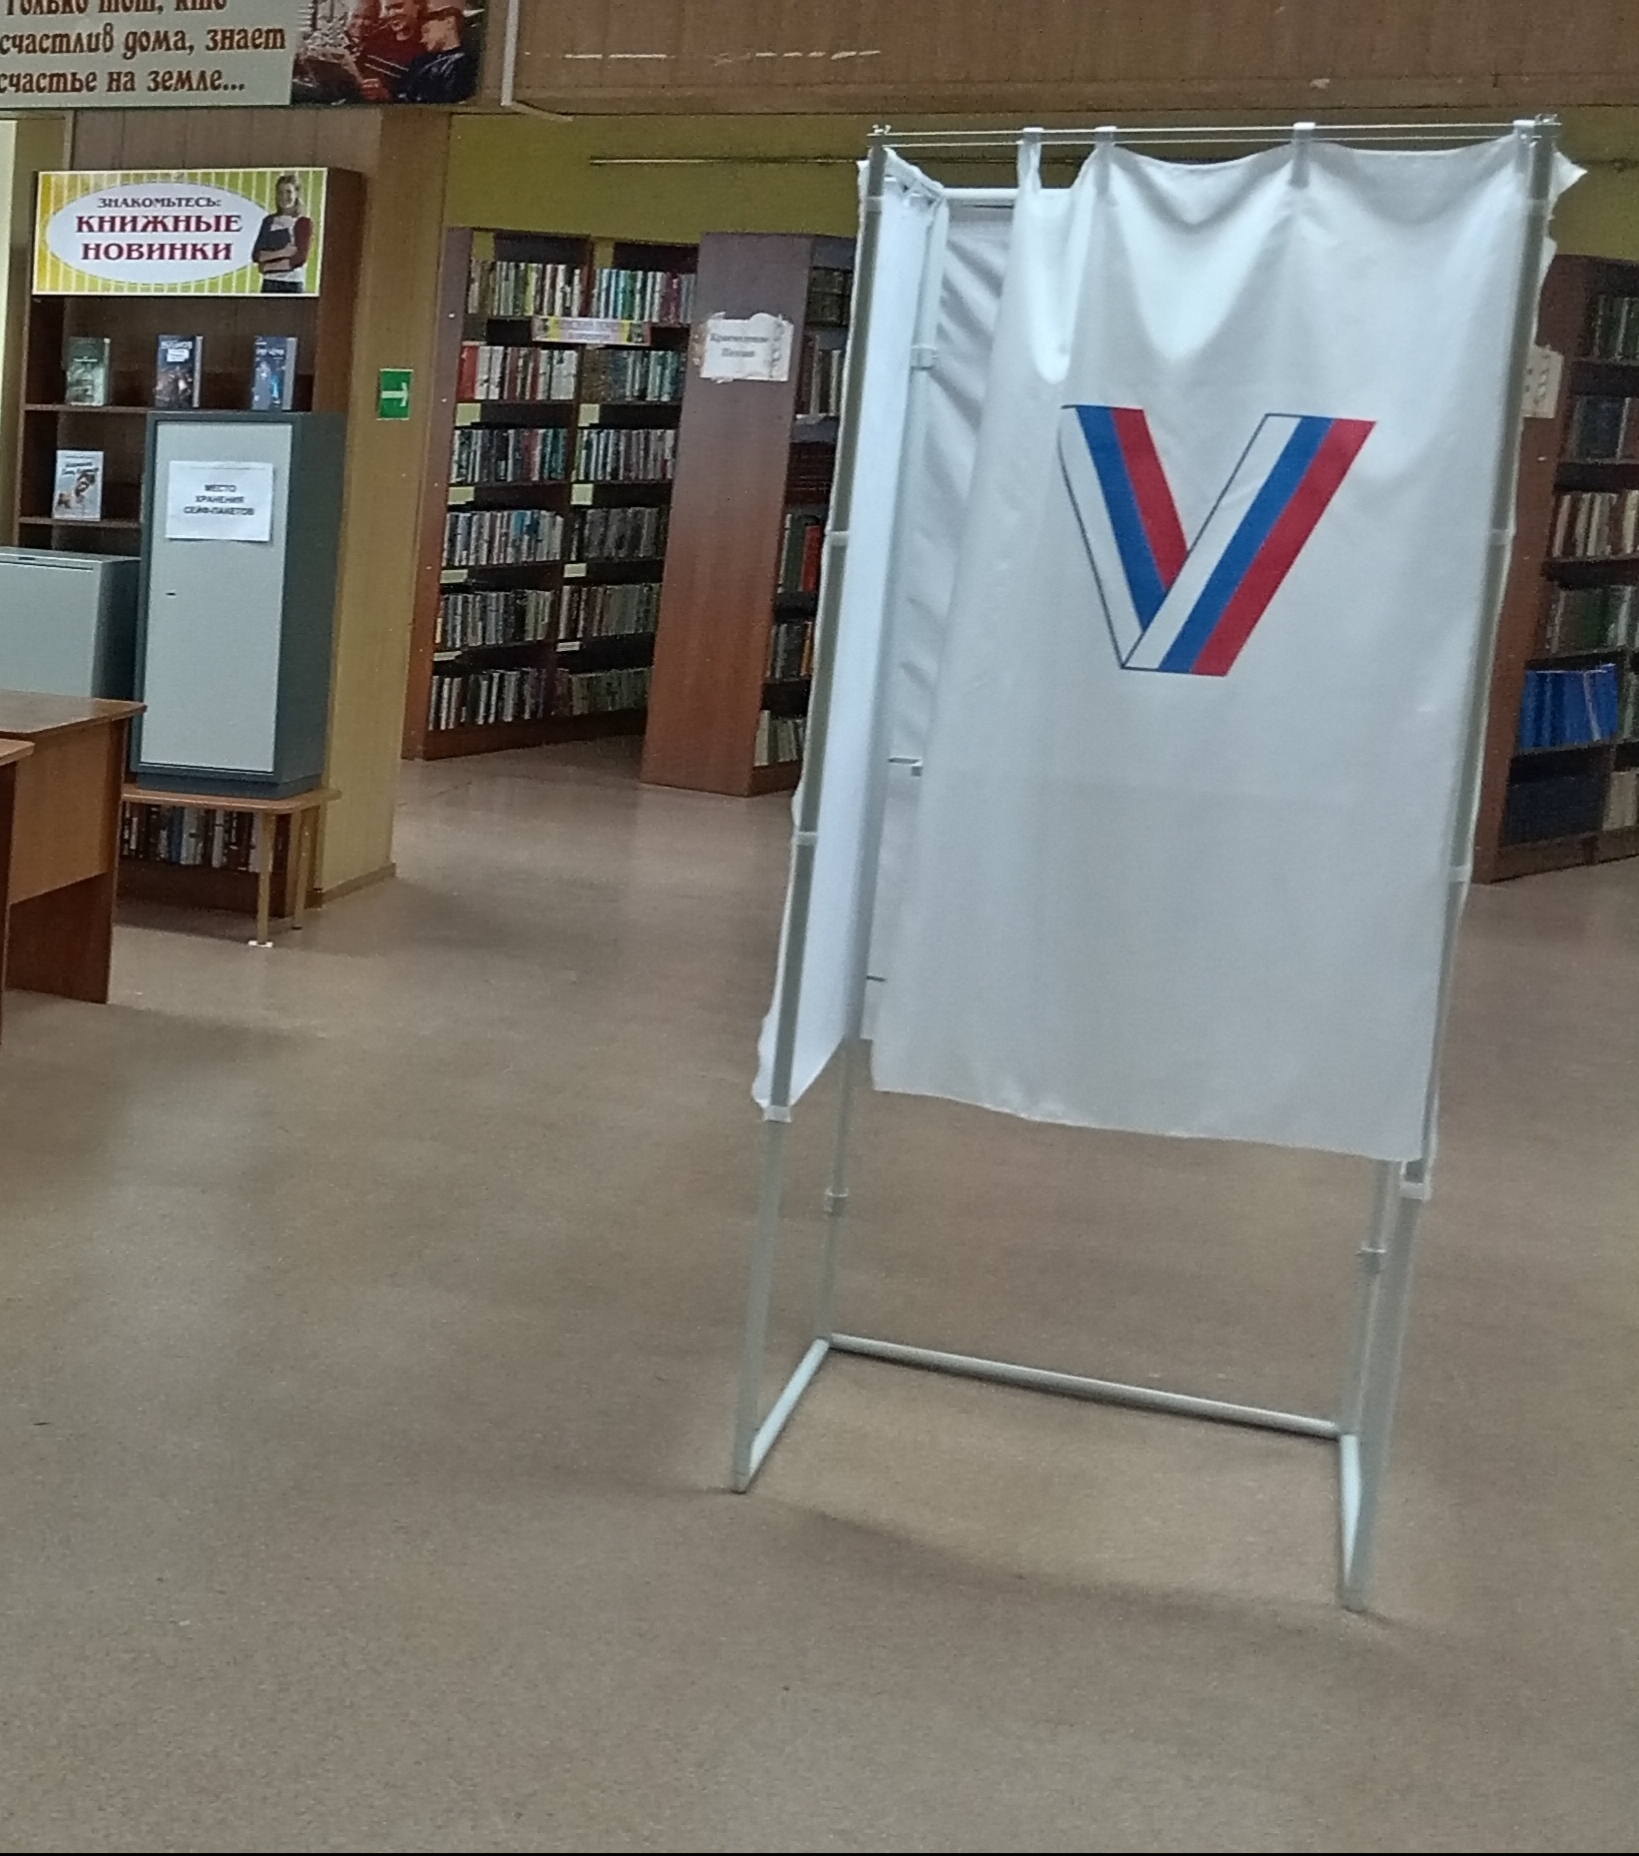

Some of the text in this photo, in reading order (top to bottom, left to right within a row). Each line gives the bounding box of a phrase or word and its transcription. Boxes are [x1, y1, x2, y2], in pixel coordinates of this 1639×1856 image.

[6, 0, 228, 16] Только тот, кто
[122, 27, 196, 60] дома,
[205, 27, 288, 51] знает
[105, 70, 137, 93] на
[146, 68, 247, 93] земле...
[96, 196, 222, 209] ЗНАКОМЬТЕСЬ:
[75, 214, 243, 234] КНИЖНЫЕ
[81, 242, 233, 262] НОВИНКИ
[204, 484, 236, 492] МЕСТО
[195, 495, 244, 503] ХРАНЕНИЯ
[184, 506, 255, 515] СЕЙФ-ПАКЕТОВ
